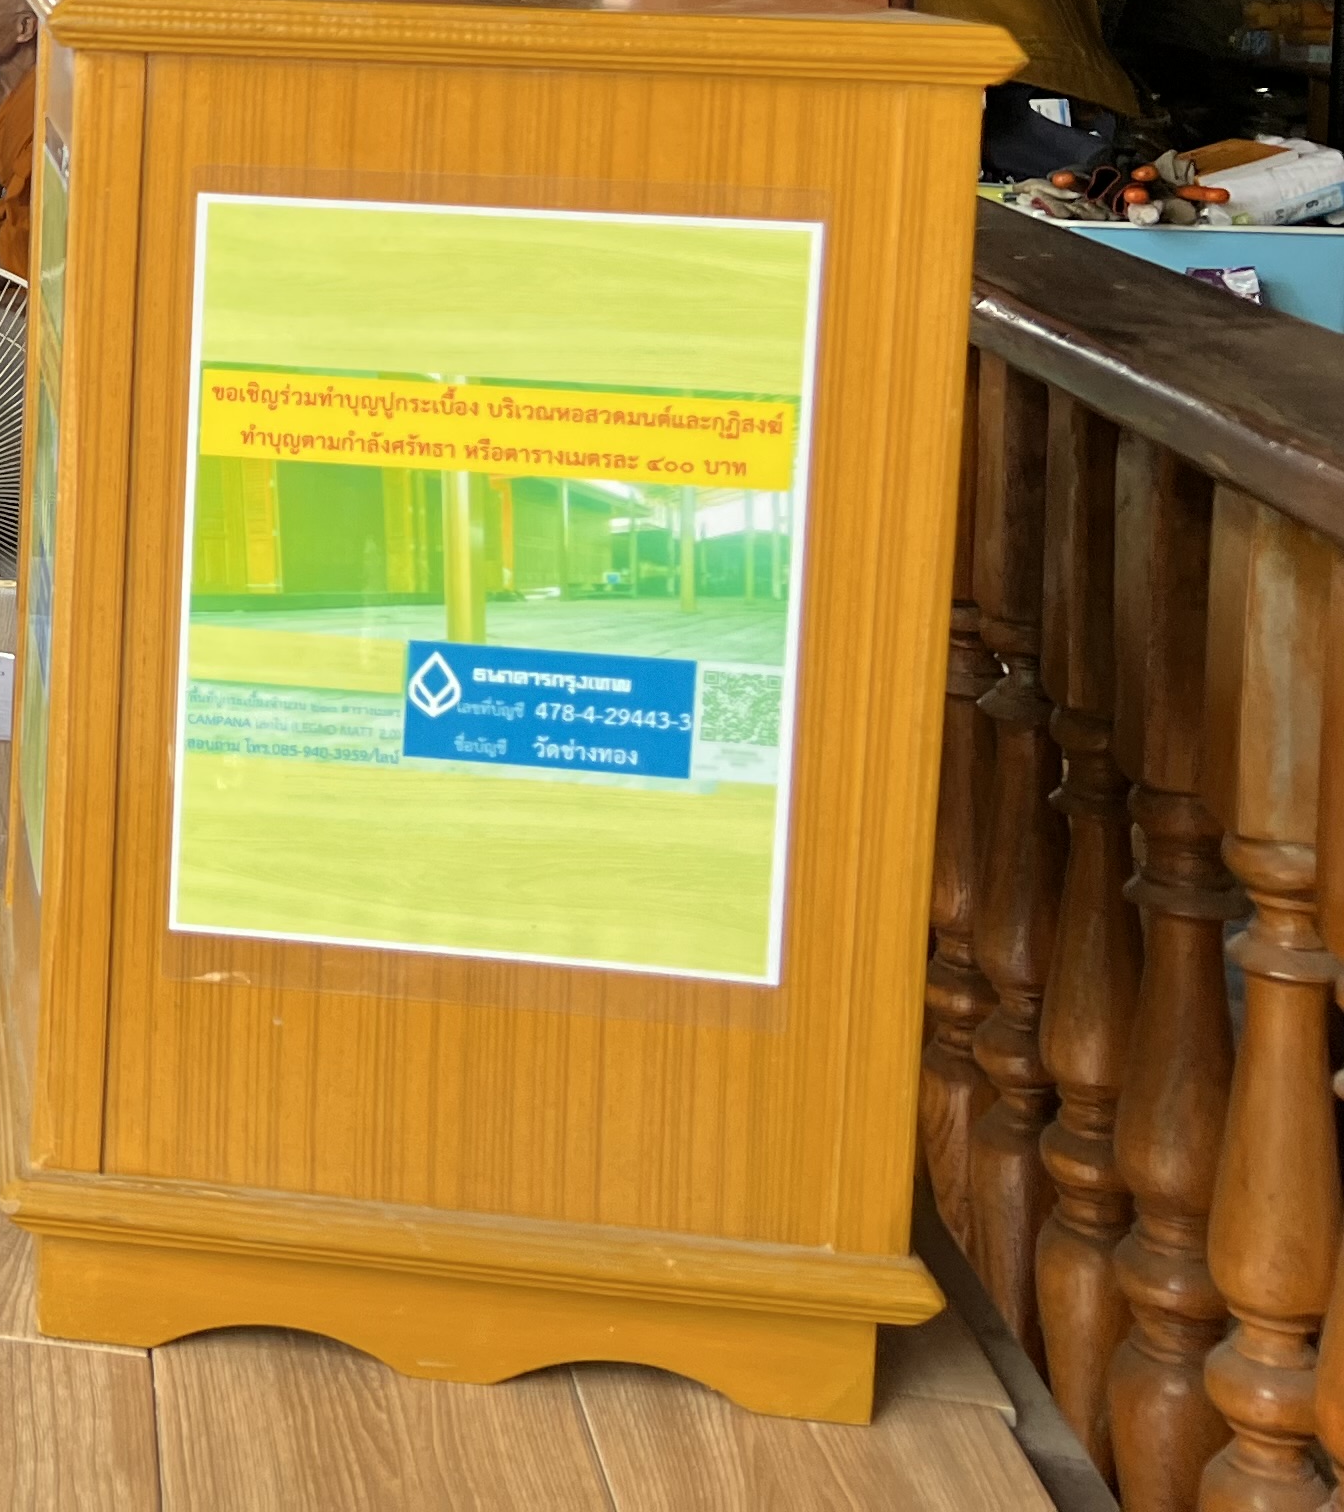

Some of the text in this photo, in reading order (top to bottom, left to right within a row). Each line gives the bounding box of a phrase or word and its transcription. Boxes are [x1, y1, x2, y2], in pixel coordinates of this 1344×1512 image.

[211, 381, 785, 439] ขอเชิญร่วมทำบุญปูกระเบื้อง บริเวณหอสวดมนต์และกุฏิสงฆ์
[240, 424, 748, 477] ทำบุญตามกำลังศรัทธา หรือตารางเมตรละ ๔๐๐ บาท
[472, 667, 633, 694] ธนาคารกรุงเทพ
[187, 713, 252, 729] CAMPANA
[534, 701, 693, 732] 478-4-29443-3
[532, 735, 640, 766] วัดช่างทอง
